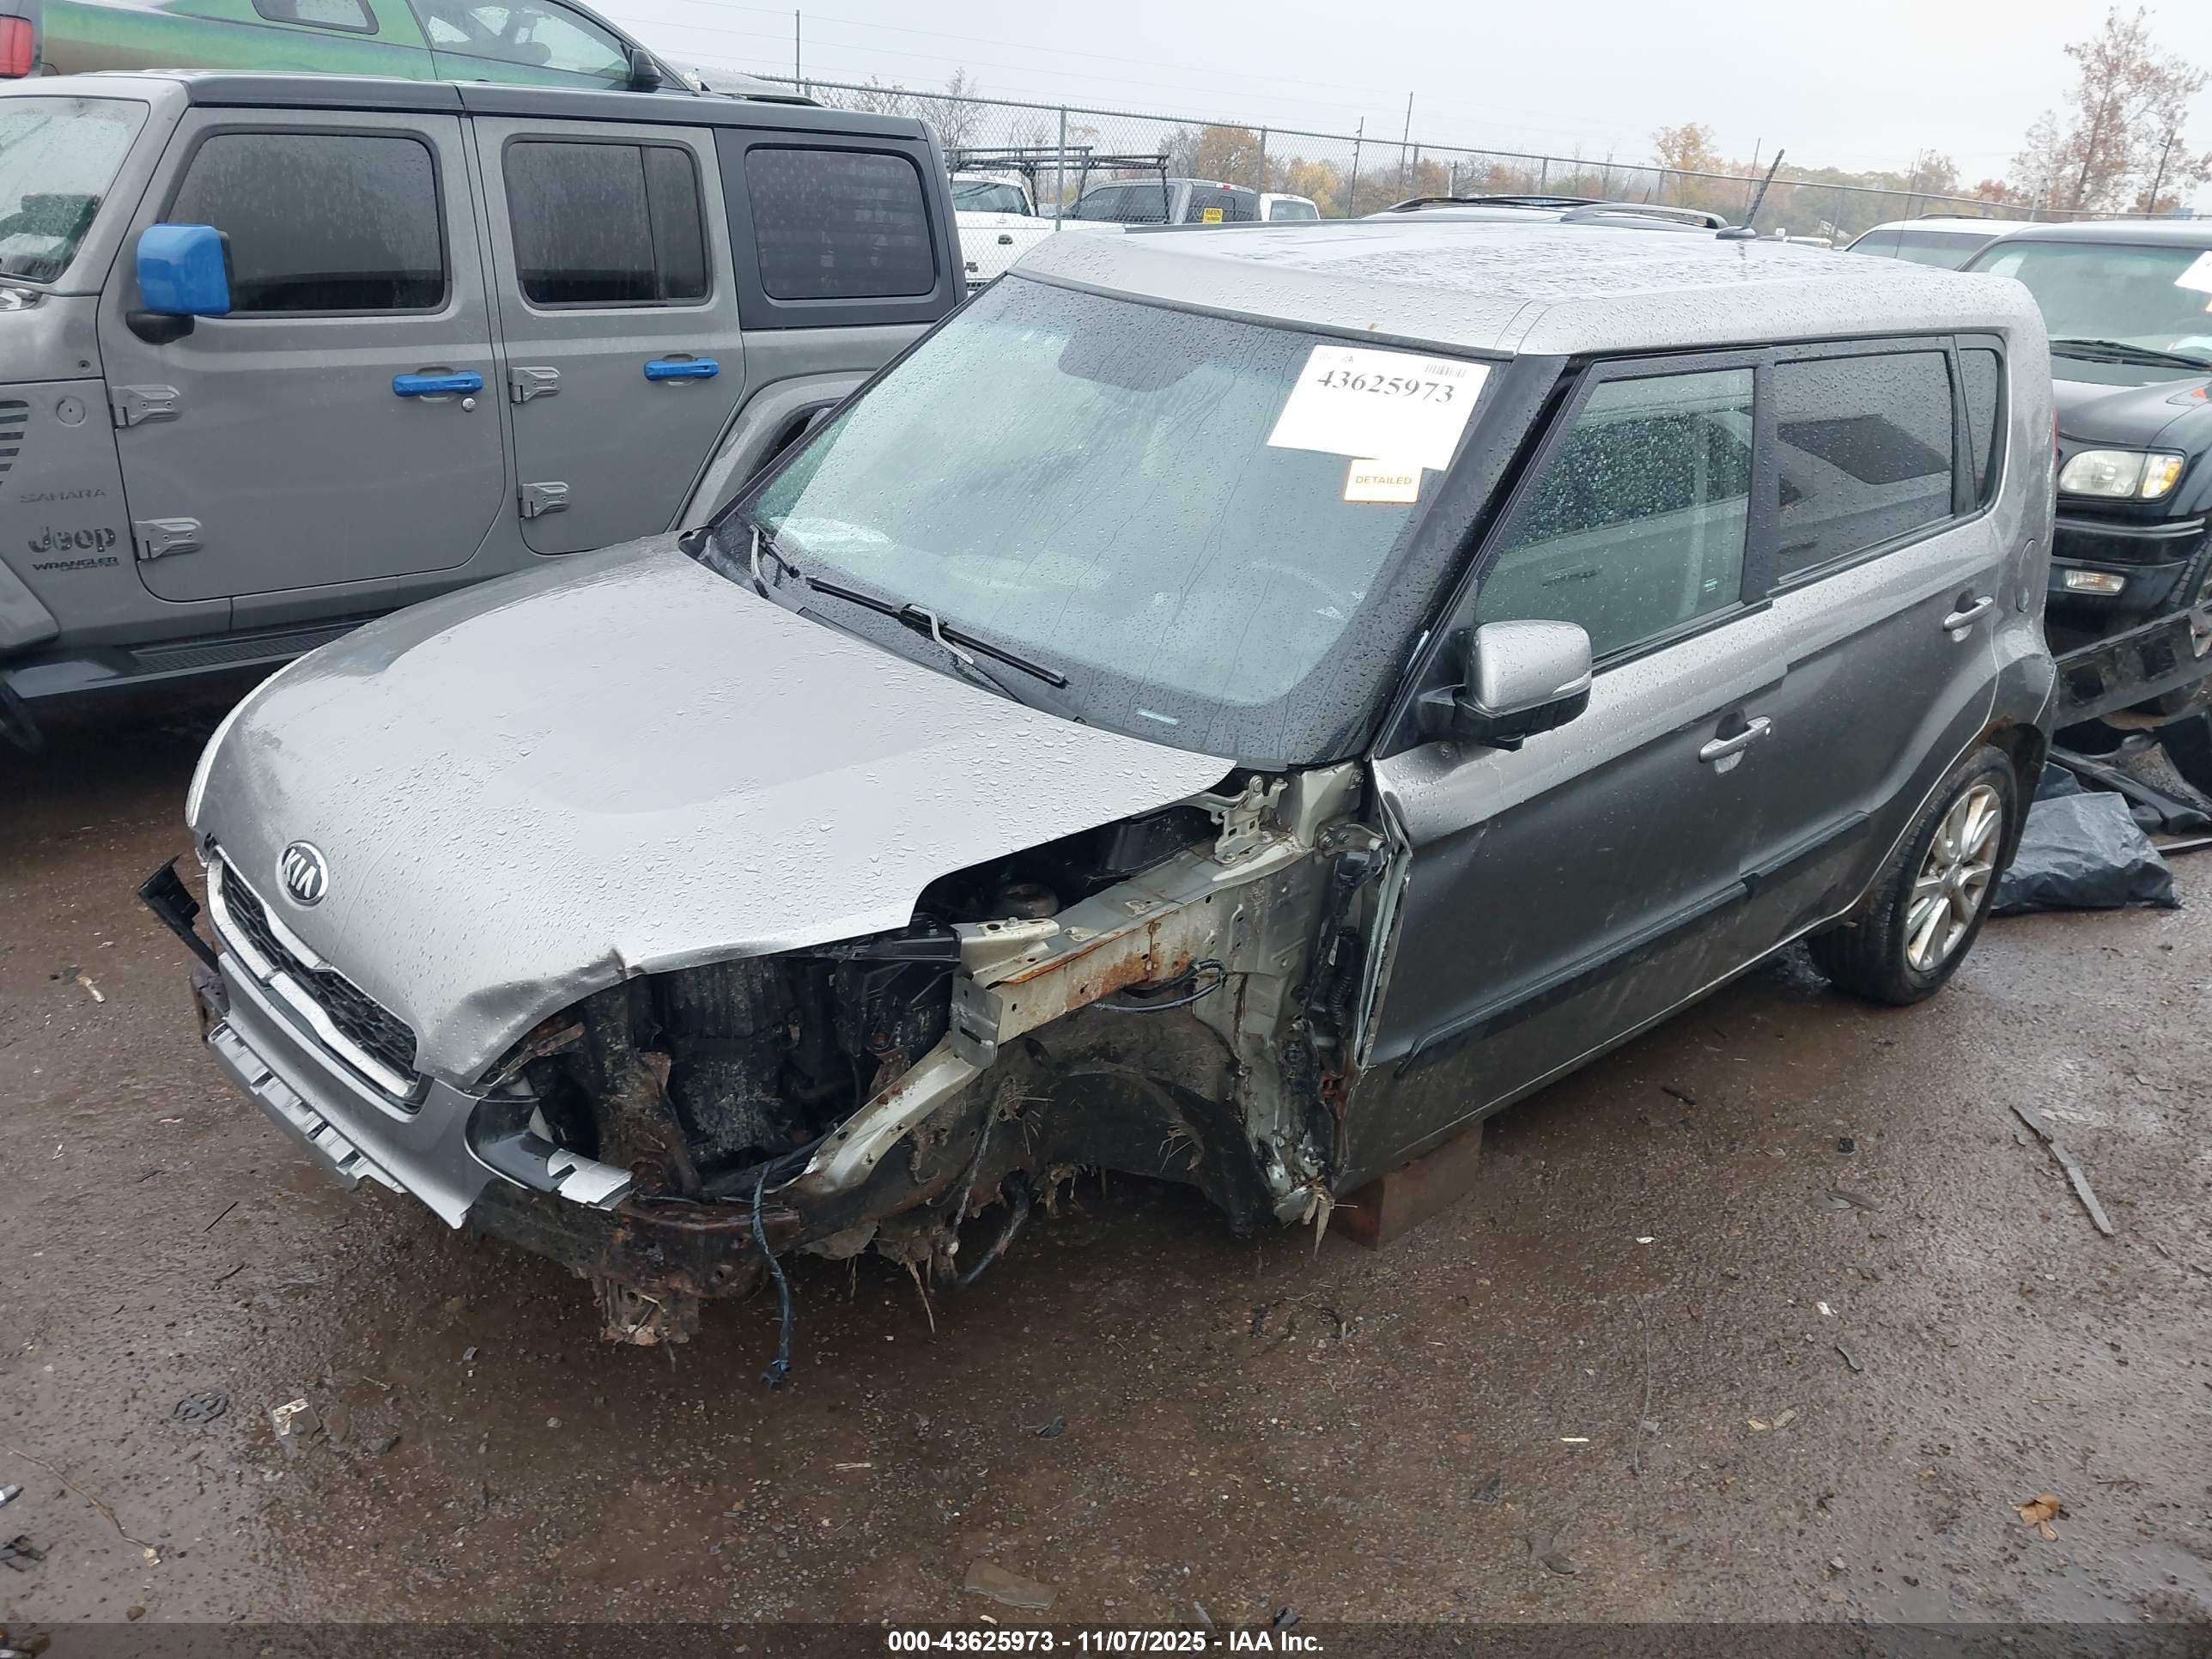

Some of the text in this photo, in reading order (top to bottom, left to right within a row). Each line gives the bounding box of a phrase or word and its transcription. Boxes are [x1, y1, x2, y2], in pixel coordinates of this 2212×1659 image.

[1316, 369, 1455, 403] 43625973
[1355, 476, 1413, 485] DETAILED
[20, 489, 106, 503] SAHARA
[28, 526, 116, 553] Jeep
[32, 556, 119, 570] WRANGLER
[283, 848, 317, 898] KIA
